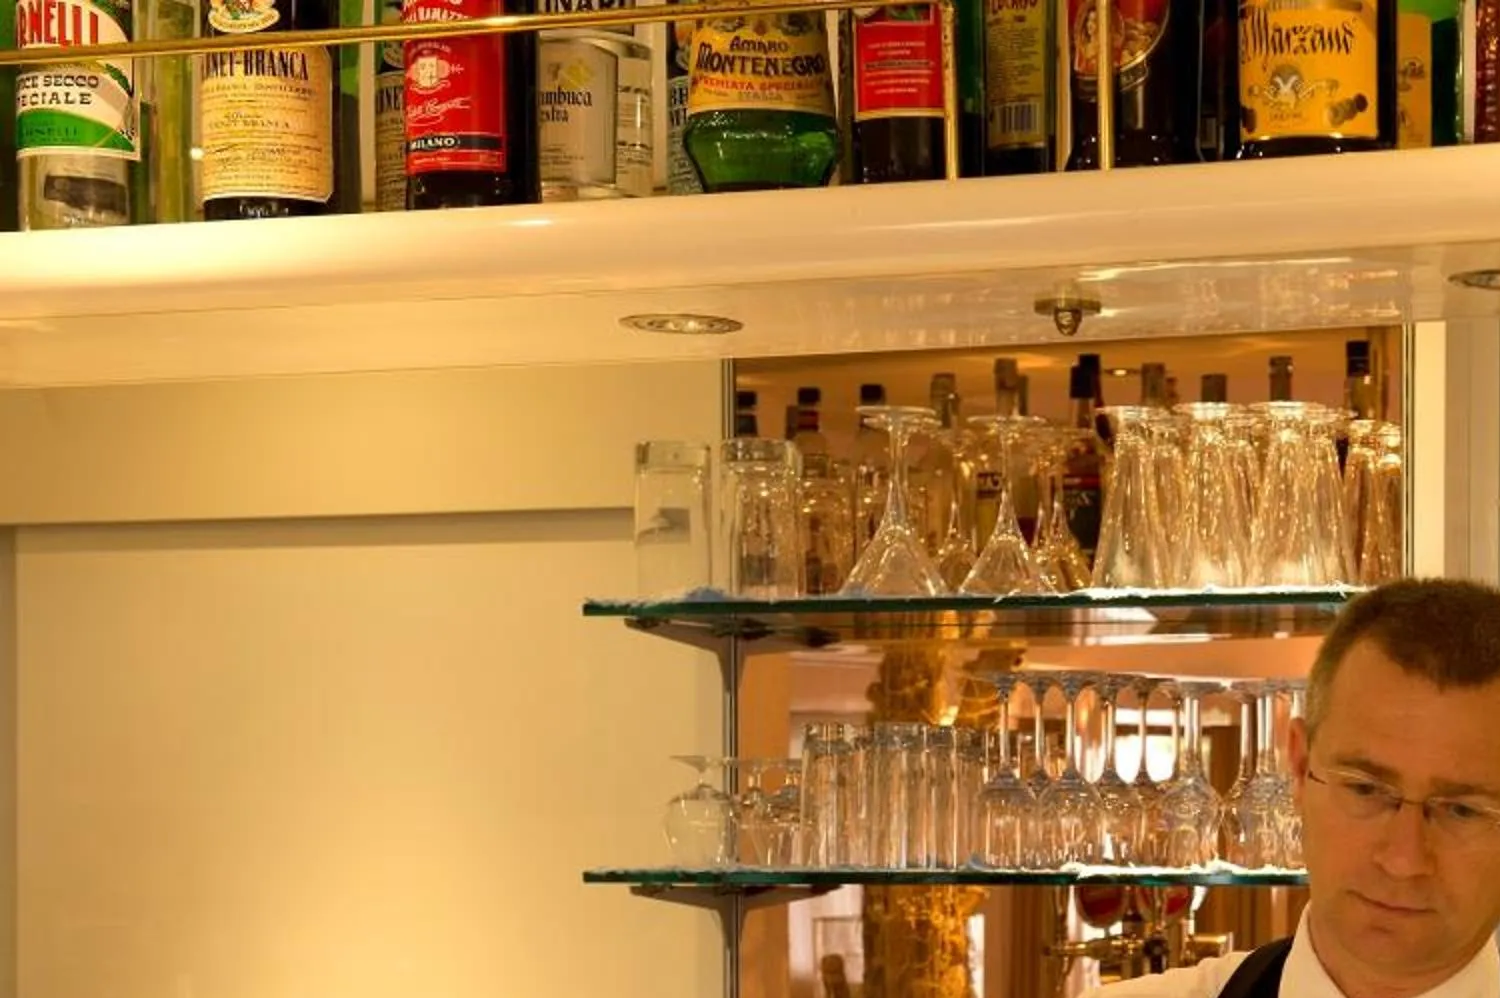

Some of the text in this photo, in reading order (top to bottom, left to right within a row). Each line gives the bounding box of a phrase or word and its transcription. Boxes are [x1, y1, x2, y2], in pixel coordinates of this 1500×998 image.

[201, 49, 309, 81] NET-BRANCA
[696, 42, 826, 76] MONTENEGRO
[43, 74, 99, 89] SECCO
